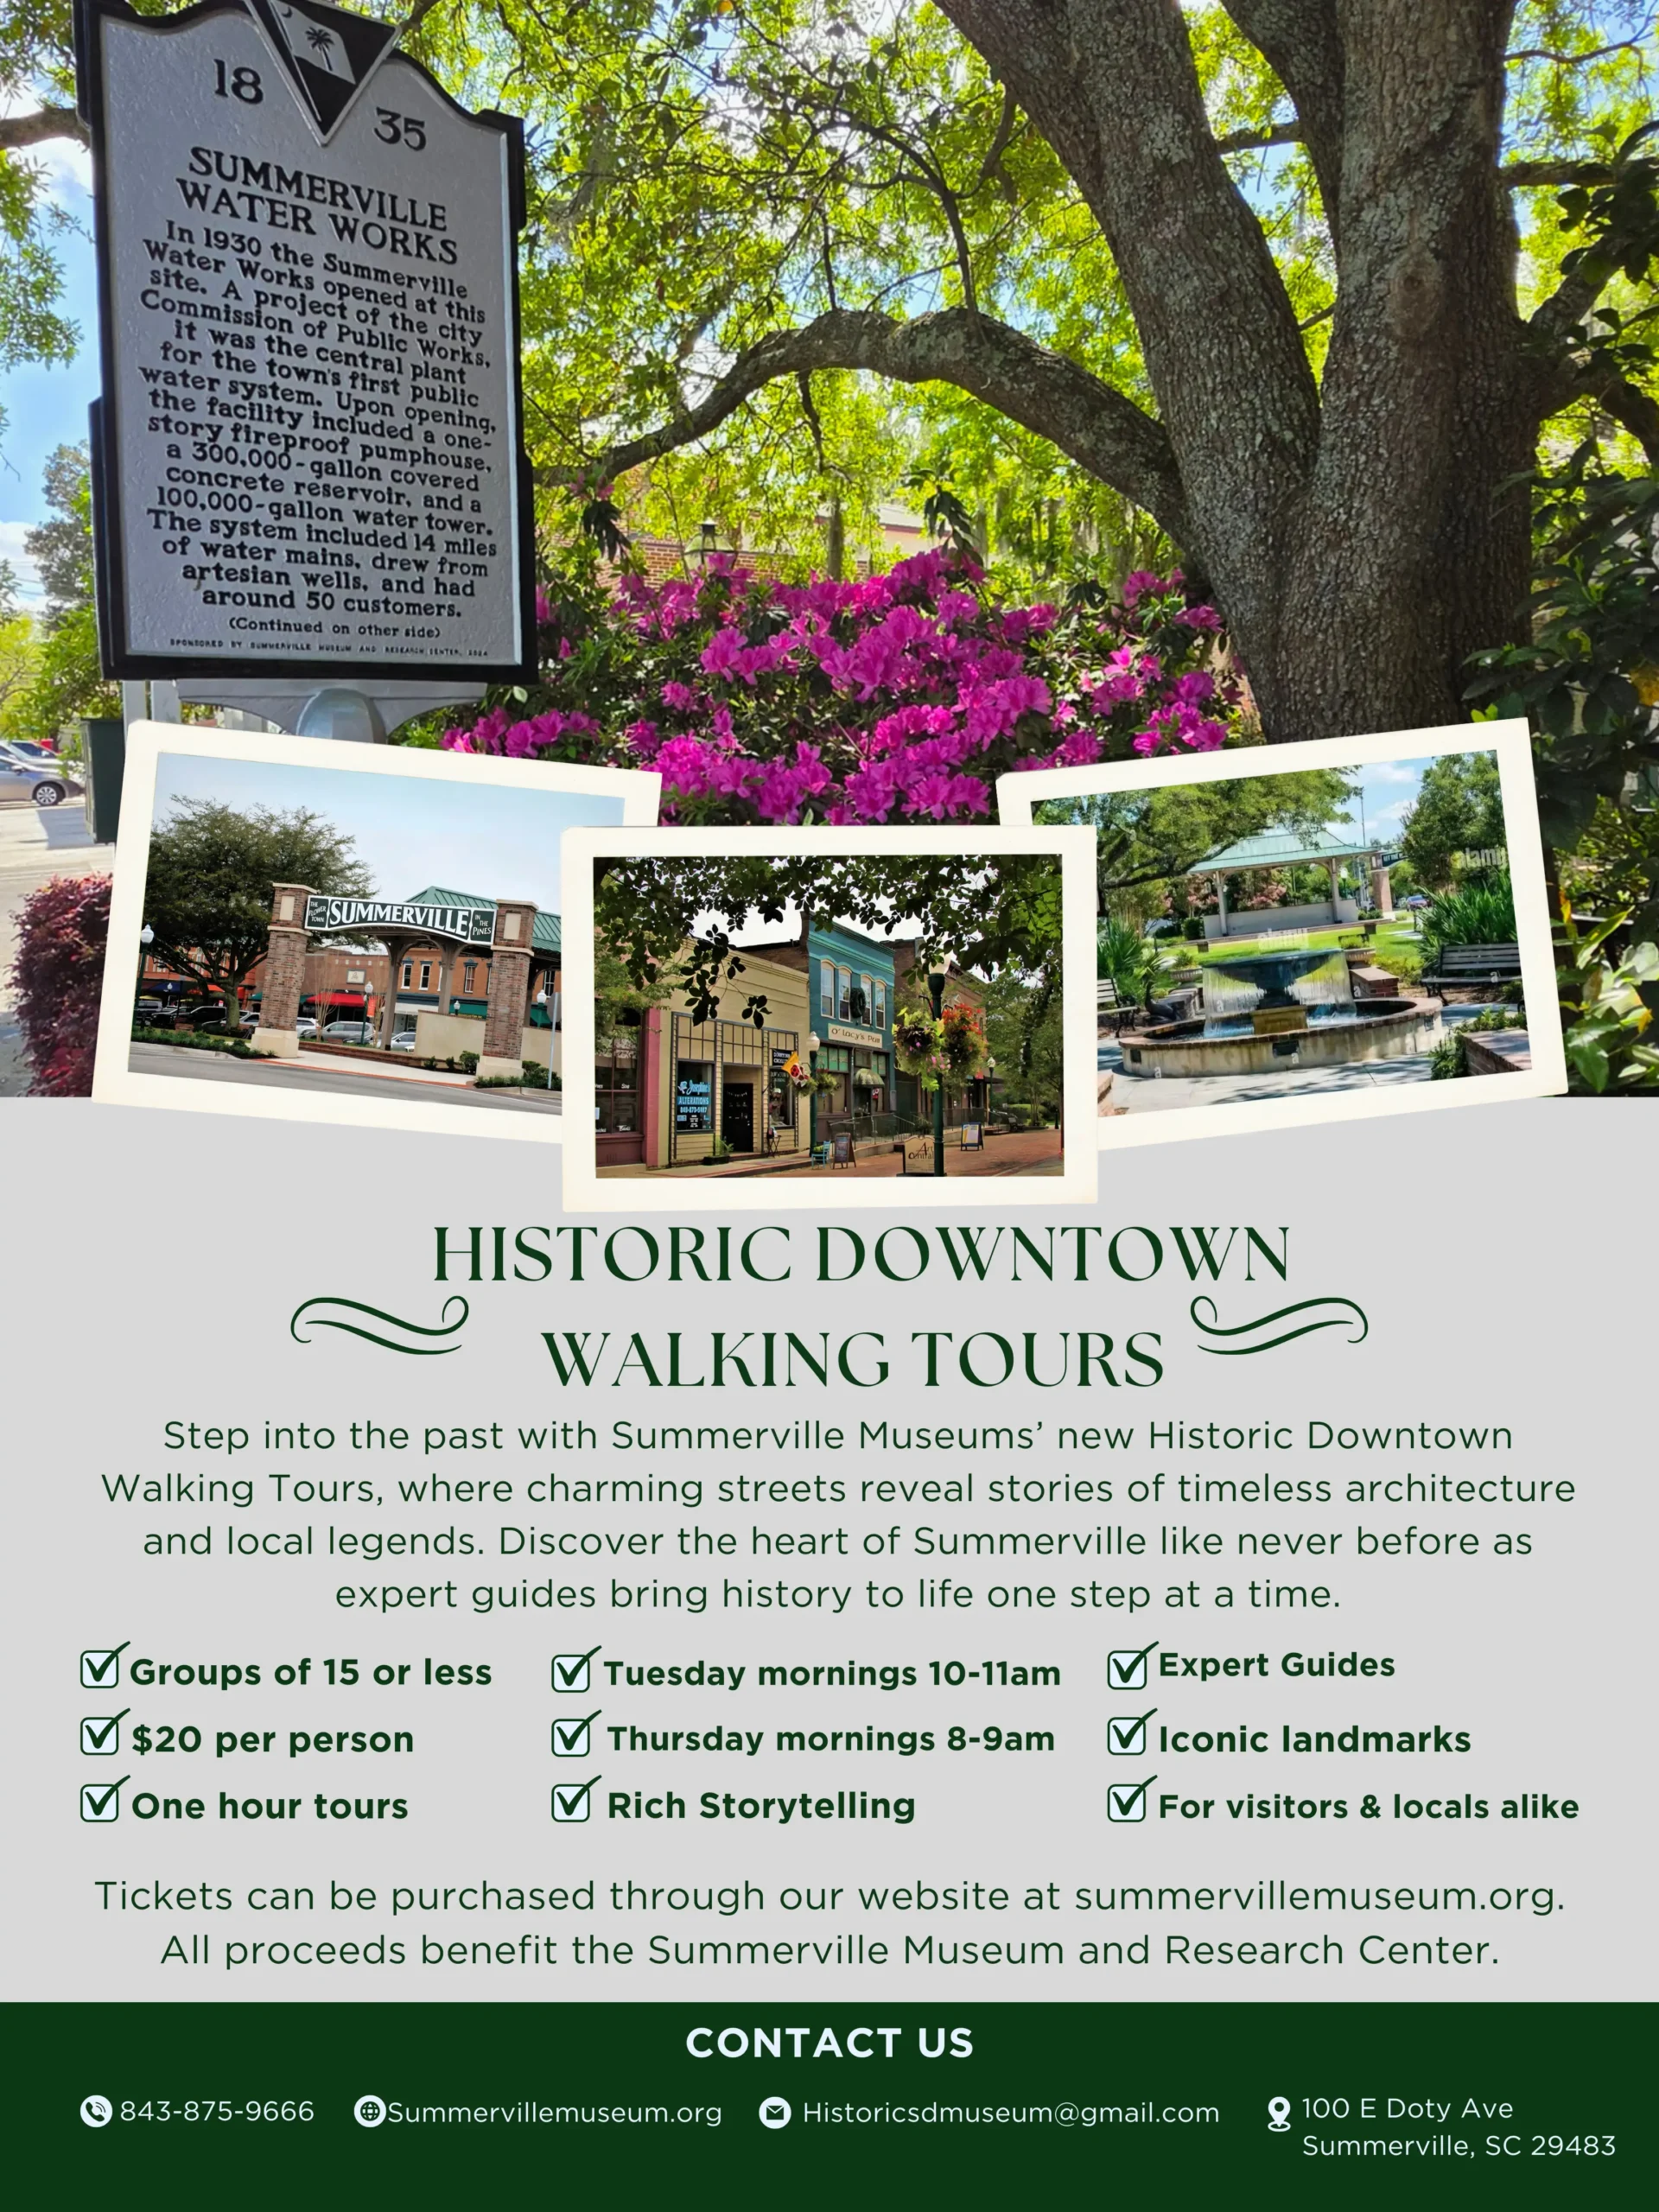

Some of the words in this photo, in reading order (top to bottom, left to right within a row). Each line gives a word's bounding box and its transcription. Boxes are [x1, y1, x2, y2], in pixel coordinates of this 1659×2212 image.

[213, 59, 264, 105] 18
[373, 107, 427, 151] 35
[188, 146, 447, 232] SUMMERVILLE
[176, 178, 317, 235] WATER
[328, 213, 458, 265] WORKS
[167, 219, 194, 244] In
[204, 227, 262, 257] 1930
[270, 242, 315, 268] the
[323, 253, 467, 299] Summerville
[150, 268, 207, 295] site.
[221, 280, 243, 301] A
[253, 289, 347, 320] project
[356, 308, 380, 326] of
[389, 312, 428, 334] the
[438, 322, 482, 348] city
[141, 289, 294, 334] Commission
[303, 321, 327, 339] of
[337, 323, 408, 353] Public
[416, 338, 491, 368] Works,
[160, 340, 202, 365] for
[212, 349, 257, 373] the
[266, 359, 340, 385] town's
[349, 372, 400, 396] first
[410, 385, 479, 408] public
[149, 389, 196, 412] the
[207, 397, 303, 430] facility
[313, 410, 413, 442] included
[423, 429, 435, 444] a
[444, 433, 492, 450] one-
[167, 443, 181, 459] a
[391, 469, 480, 492] covered
[353, 509, 419, 529] water
[425, 512, 493, 536] tower.
[162, 536, 190, 555] of
[200, 541, 276, 562] water
[285, 548, 360, 569] mains,
[372, 552, 429, 573] drew
[437, 556, 488, 576] from
[202, 589, 296, 608] around
[306, 592, 334, 611] 50
[344, 597, 461, 618] customers.
[229, 617, 323, 633] (Continued
[332, 625, 350, 634] on
[358, 624, 399, 637] other
[404, 626, 441, 639] side)
[251, 642, 311, 651] SUMMERVILLE
[308, 906, 327, 916] FLOWER
[329, 900, 469, 936] SUMMERVILLE
[435, 1227, 791, 1281] HISTORIC
[817, 1227, 1289, 1281] DOWNTOWN
[541, 1332, 888, 1387] WALKING
[912, 1332, 1163, 1387] TOURS
[164, 1421, 249, 1454] Step
[265, 1421, 334, 1449] into
[350, 1421, 409, 1449] the
[425, 1422, 503, 1454] past
[518, 1421, 596, 1449] with
[613, 1421, 843, 1449] Summerville
[1059, 1428, 1134, 1449] new
[1151, 1421, 1293, 1449] Historic
[1309, 1421, 1511, 1449] Downtown
[336, 1581, 457, 1613] expert
[473, 1579, 595, 1613] guides
[612, 1579, 706, 1613] bring
[724, 1579, 851, 1613] history
[867, 1581, 903, 1607] to
[920, 1579, 973, 1607] life
[988, 1586, 1055, 1607] one
[1071, 1581, 1150, 1613] step
[1166, 1581, 1199, 1607] at
[1215, 1586, 1233, 1607] a
[1249, 1580, 1338, 1607] time.
[130, 1659, 261, 1690] Groups
[275, 1658, 311, 1685] of
[323, 1659, 359, 1685] 15
[373, 1665, 410, 1685] or
[425, 1658, 492, 1685] less
[604, 1661, 746, 1690] Tuesday
[760, 1661, 917, 1690] mornings
[929, 1661, 1059, 1686] 10-11am
[1160, 1653, 1268, 1681] Expert
[1281, 1652, 1395, 1676] Guides
[132, 1725, 201, 1756] $20
[217, 1732, 276, 1758] per
[290, 1732, 412, 1758] person
[607, 1726, 764, 1756] Thursday
[778, 1726, 935, 1756] mornings
[948, 1726, 1053, 1751] 8-9am
[1160, 1726, 1268, 1752] Iconic
[1283, 1726, 1471, 1752] landmarks
[132, 1793, 205, 1819] One
[219, 1792, 302, 1819] hour
[315, 1794, 408, 1819] tours
[609, 1791, 684, 1818] Rich
[700, 1791, 914, 1824] Storytelling
[1160, 1795, 1214, 1818] For
[1226, 1794, 1347, 1818] visitors
[1360, 1795, 1381, 1818] &
[1395, 1794, 1489, 1818] locals
[1502, 1794, 1579, 1818] alike
[95, 1880, 232, 1910] Tickets
[248, 1888, 313, 1910] can
[332, 1880, 376, 1910] be
[393, 1880, 594, 1916] purchased
[610, 1880, 763, 1916] through
[780, 1888, 843, 1910] our
[858, 1880, 1008, 1910] website
[1024, 1883, 1059, 1910] at
[1076, 1880, 1563, 1916] summervillemuseum.org.
[687, 2028, 901, 2057] CONTACT
[919, 2028, 972, 2057] US
[121, 2101, 314, 2120] 843-875-9666
[389, 2102, 721, 2126] Summervillemuseum.org
[804, 2102, 1218, 2126] Historicsdmuseum@gmail.com
[1303, 2098, 1349, 2118] 100
[1362, 2099, 1376, 2118] E
[1389, 2099, 1451, 2122] Doty
[1461, 2098, 1513, 2118] Ave
[1303, 2135, 1474, 2158] Summerville,
[1486, 2136, 1521, 2155] SC
[1532, 2136, 1615, 2155] 29483
